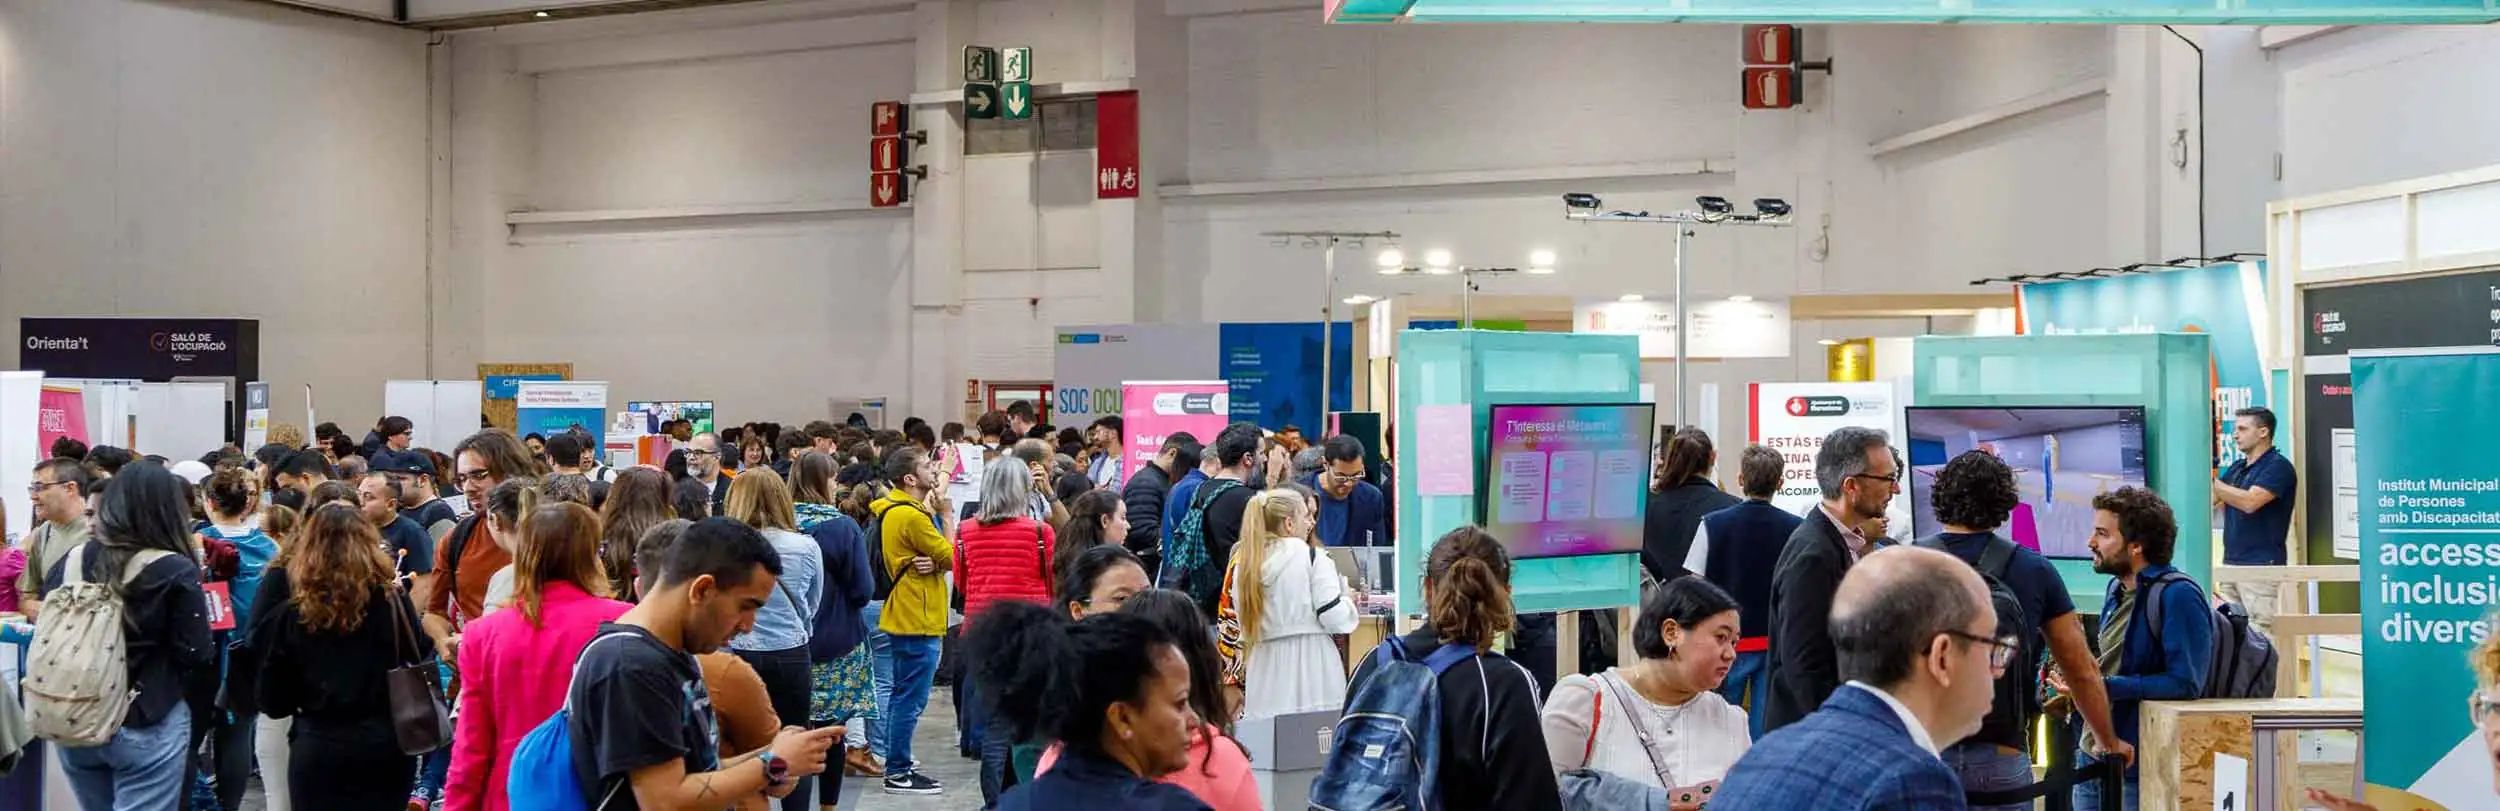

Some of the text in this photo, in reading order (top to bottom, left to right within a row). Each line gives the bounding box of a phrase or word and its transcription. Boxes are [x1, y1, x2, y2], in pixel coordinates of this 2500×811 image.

[26, 336, 89, 350] Orienta't
[171, 332, 211, 342] SALÓ DE
[171, 341, 226, 351] L'OCUPACIÓ
[1059, 388, 1123, 414] SOC OCU
[1784, 453, 1810, 464] INA
[1783, 469, 1817, 480] OFE
[1777, 487, 1822, 496] ACOMP
[2378, 478, 2498, 494] Institut Municipal
[2378, 495, 2465, 508] de Persones
[2378, 511, 2500, 526] amb Discapacitat
[2379, 542, 2500, 567] access
[2381, 574, 2500, 605] inclusi
[2381, 611, 2491, 643] divers
